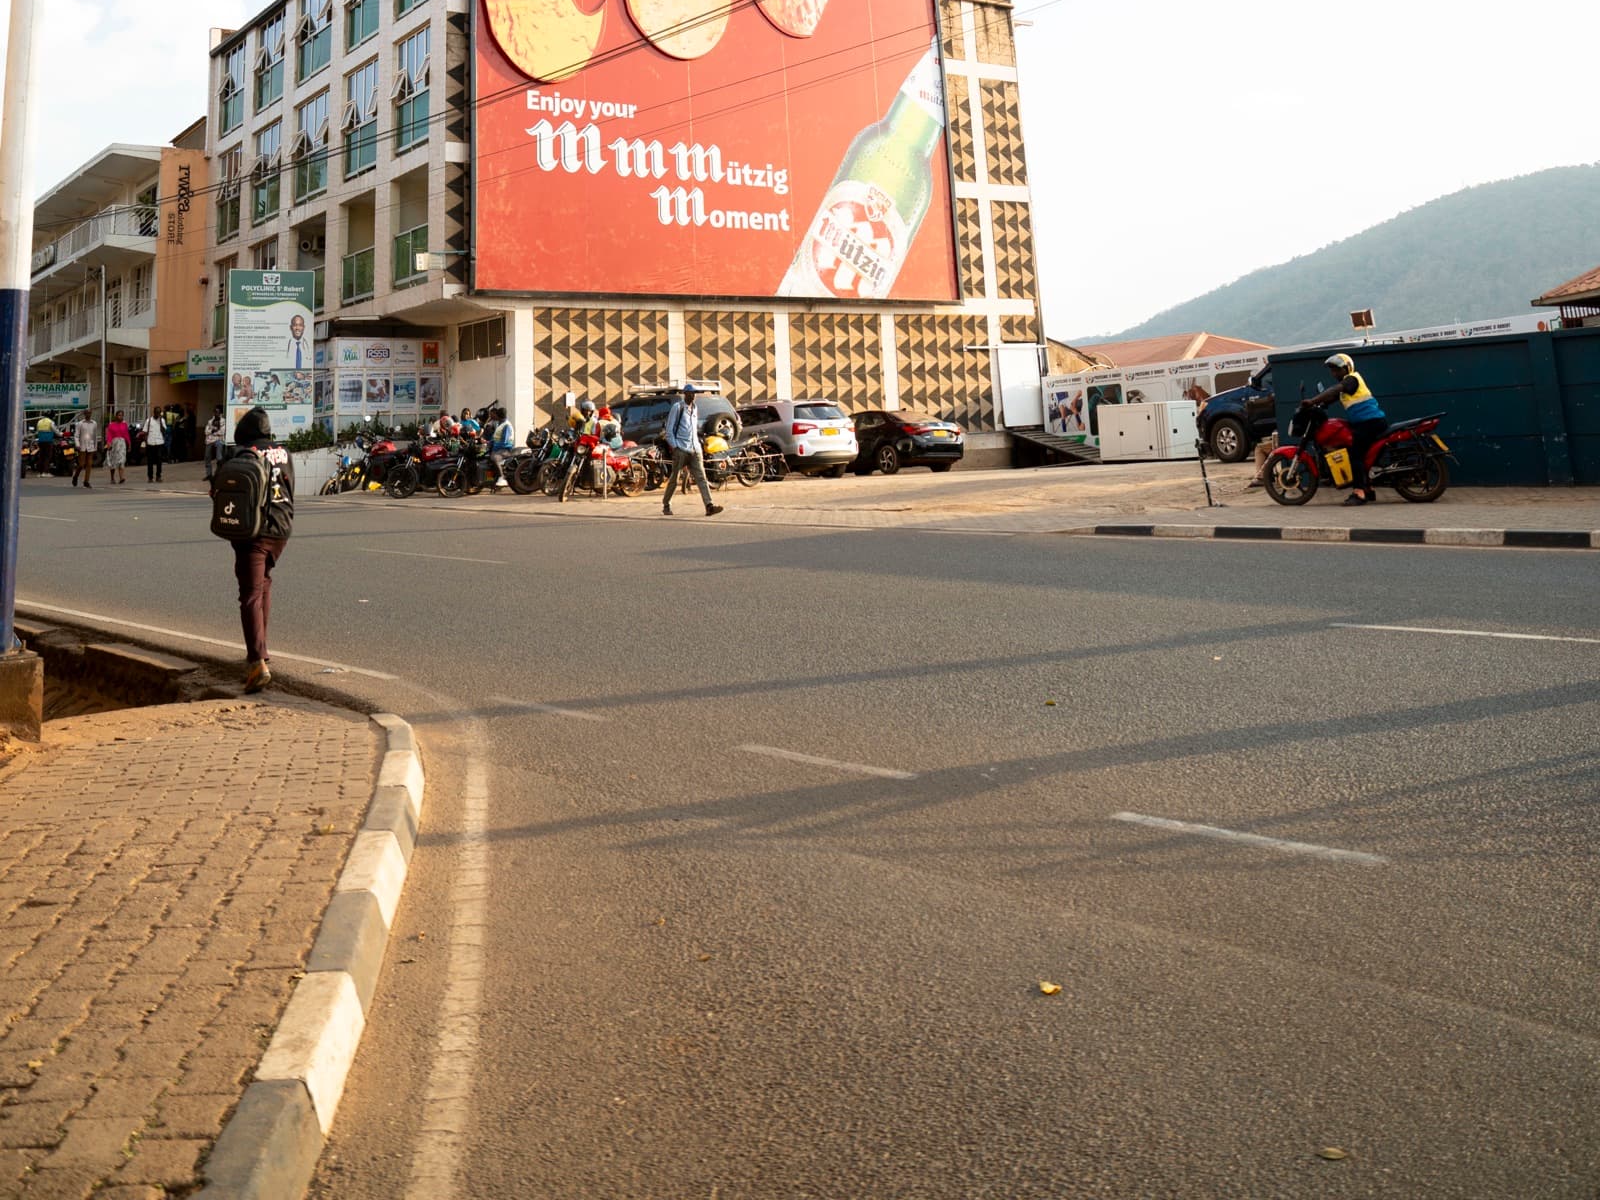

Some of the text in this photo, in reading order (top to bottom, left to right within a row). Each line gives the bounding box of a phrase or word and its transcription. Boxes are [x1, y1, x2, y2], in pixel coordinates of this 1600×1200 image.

[526, 89, 638, 119] Enjoy your
[167, 212, 176, 246] STORE
[367, 349, 389, 358] RSSB
[35, 383, 88, 392] PHARMACY
[220, 517, 240, 525] TikTok
